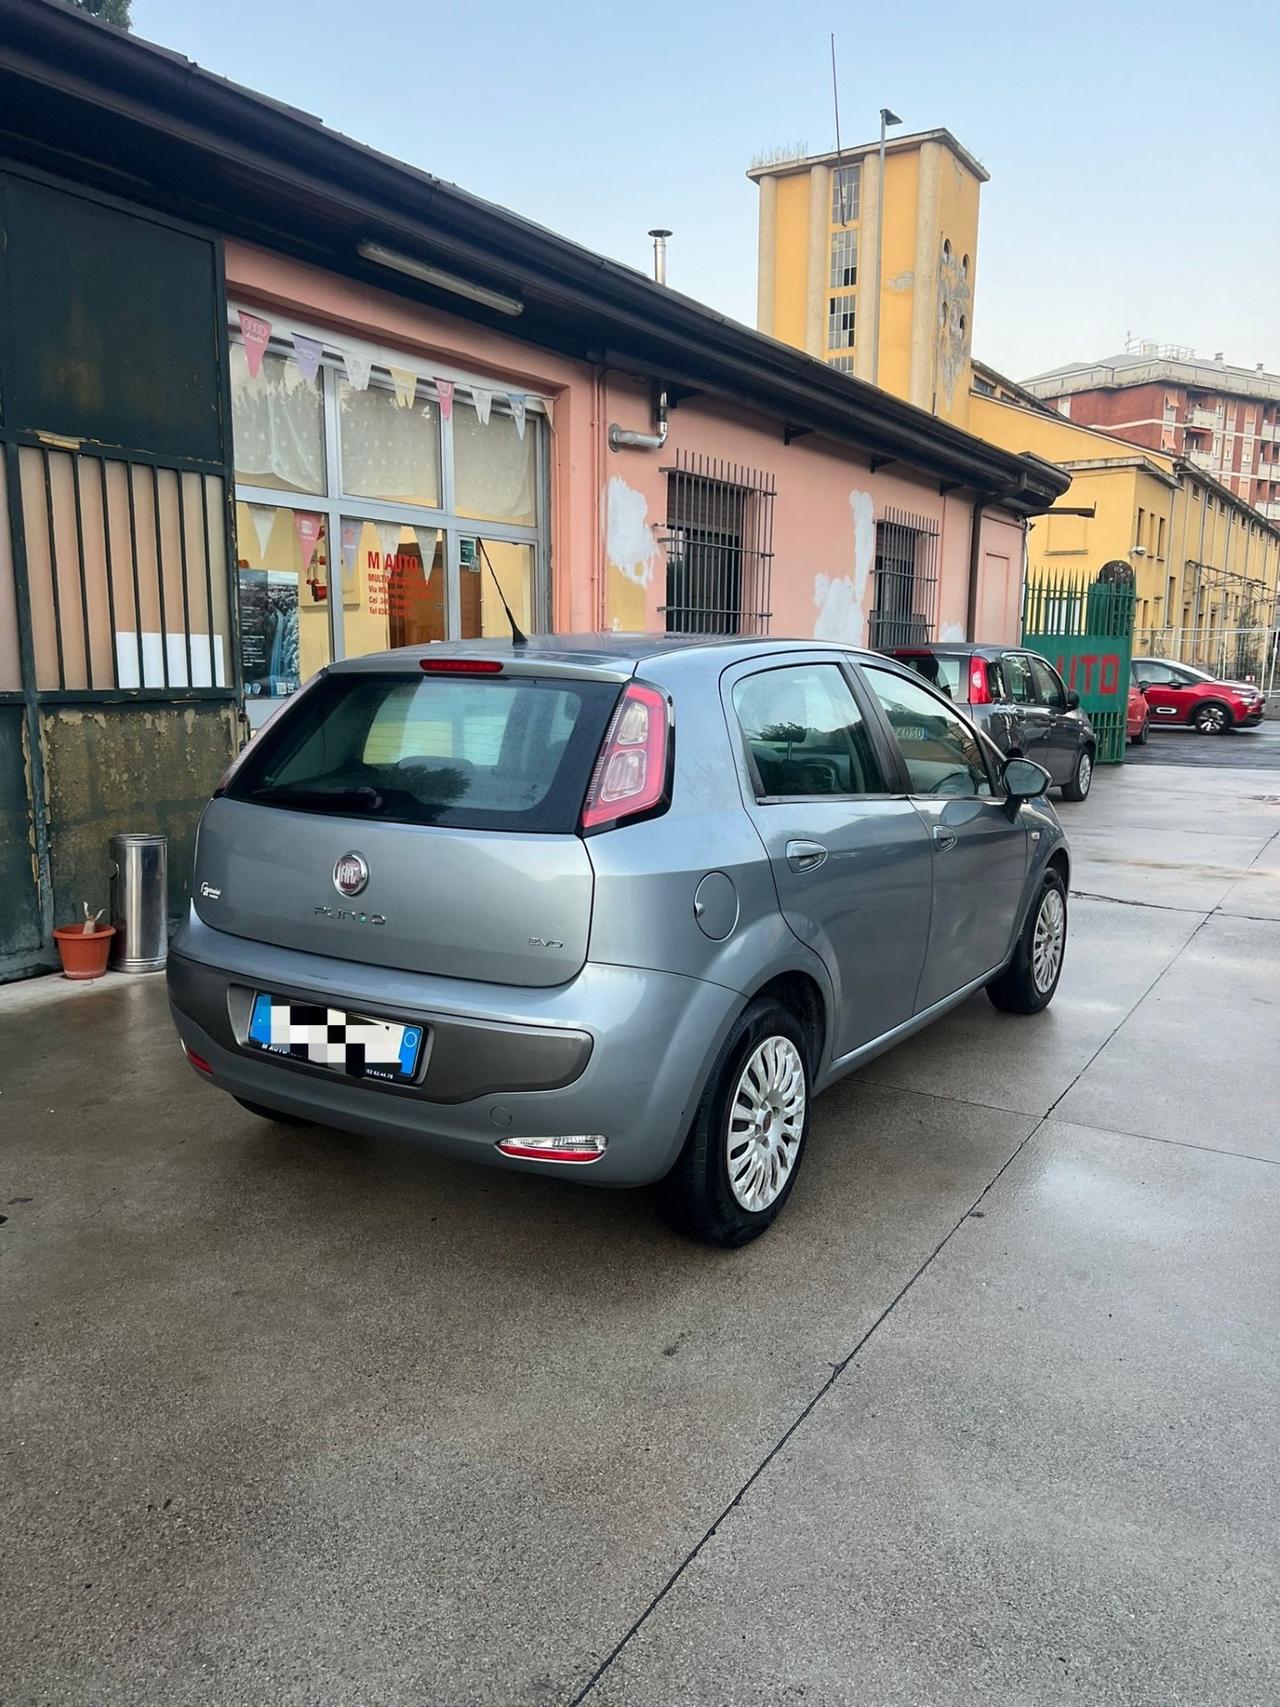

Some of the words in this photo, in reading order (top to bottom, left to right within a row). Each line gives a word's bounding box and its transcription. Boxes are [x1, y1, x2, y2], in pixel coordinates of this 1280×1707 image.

[368, 551, 380, 569] M
[384, 553, 418, 575] AUTO
[339, 865, 361, 885] FIAT
[312, 905, 386, 925] PUNTO
